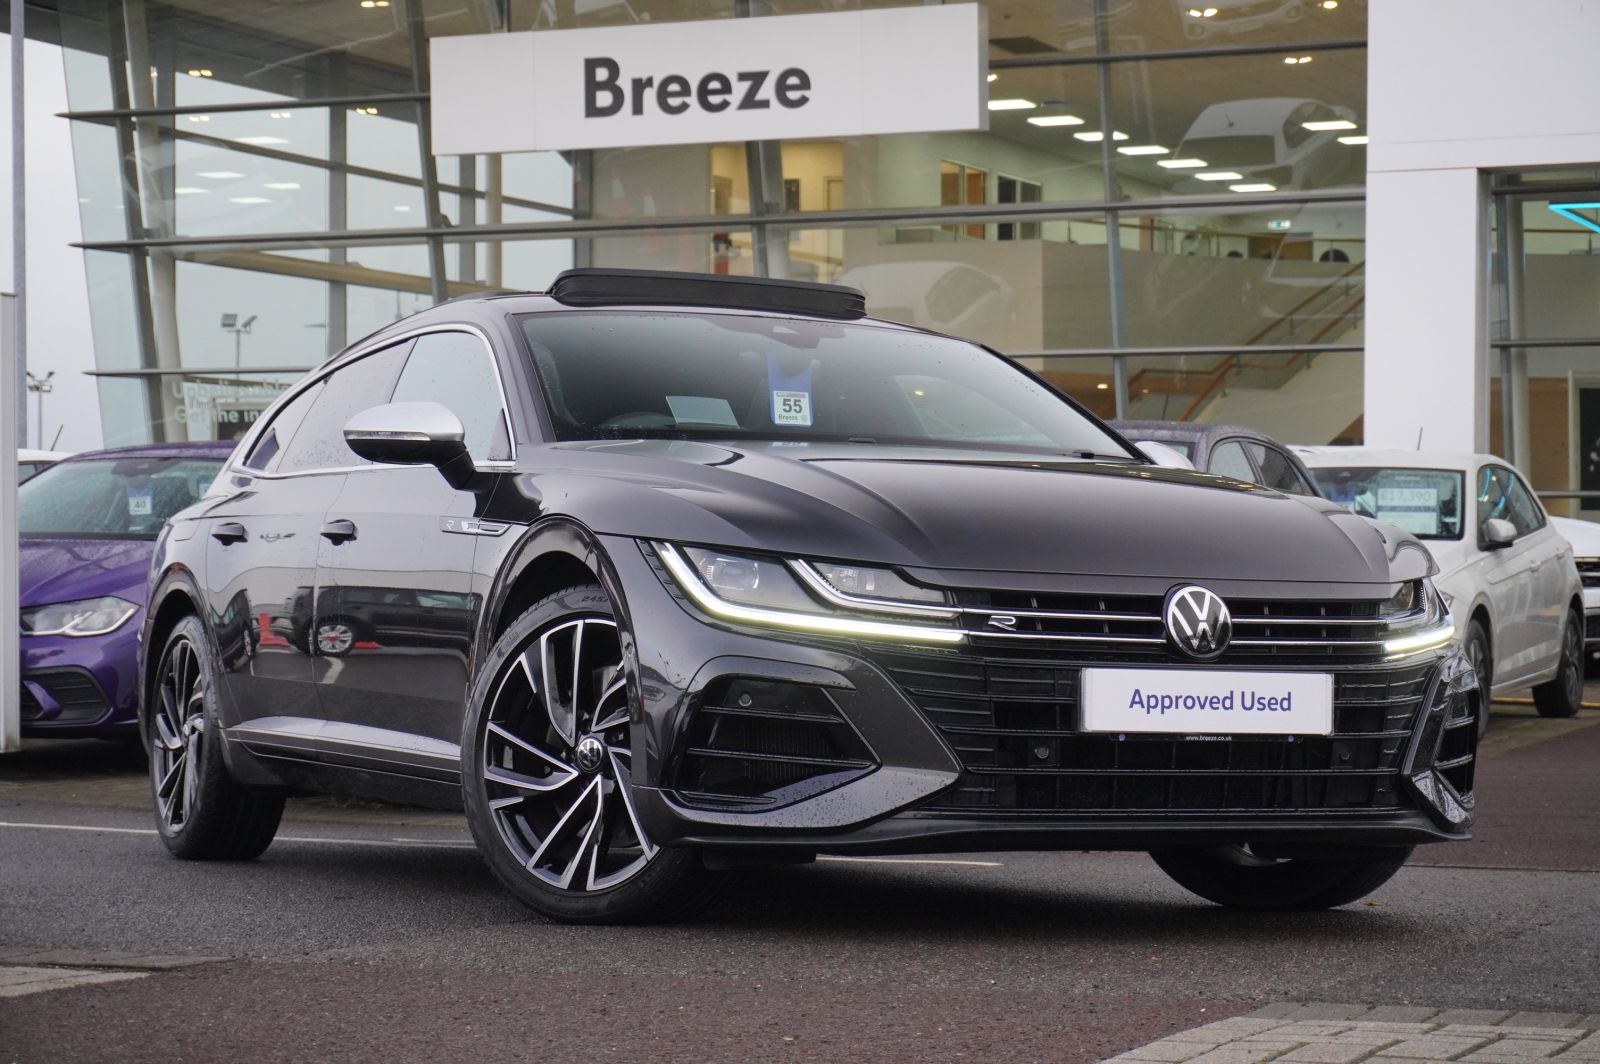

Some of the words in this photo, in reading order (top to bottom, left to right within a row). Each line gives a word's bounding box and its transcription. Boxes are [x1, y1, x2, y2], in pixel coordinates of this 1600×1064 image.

[584, 56, 812, 118] Breeze
[782, 398, 803, 414] 55
[778, 413, 799, 421] Breeze
[1128, 688, 1235, 715] Approved
[1240, 690, 1292, 712] Used
